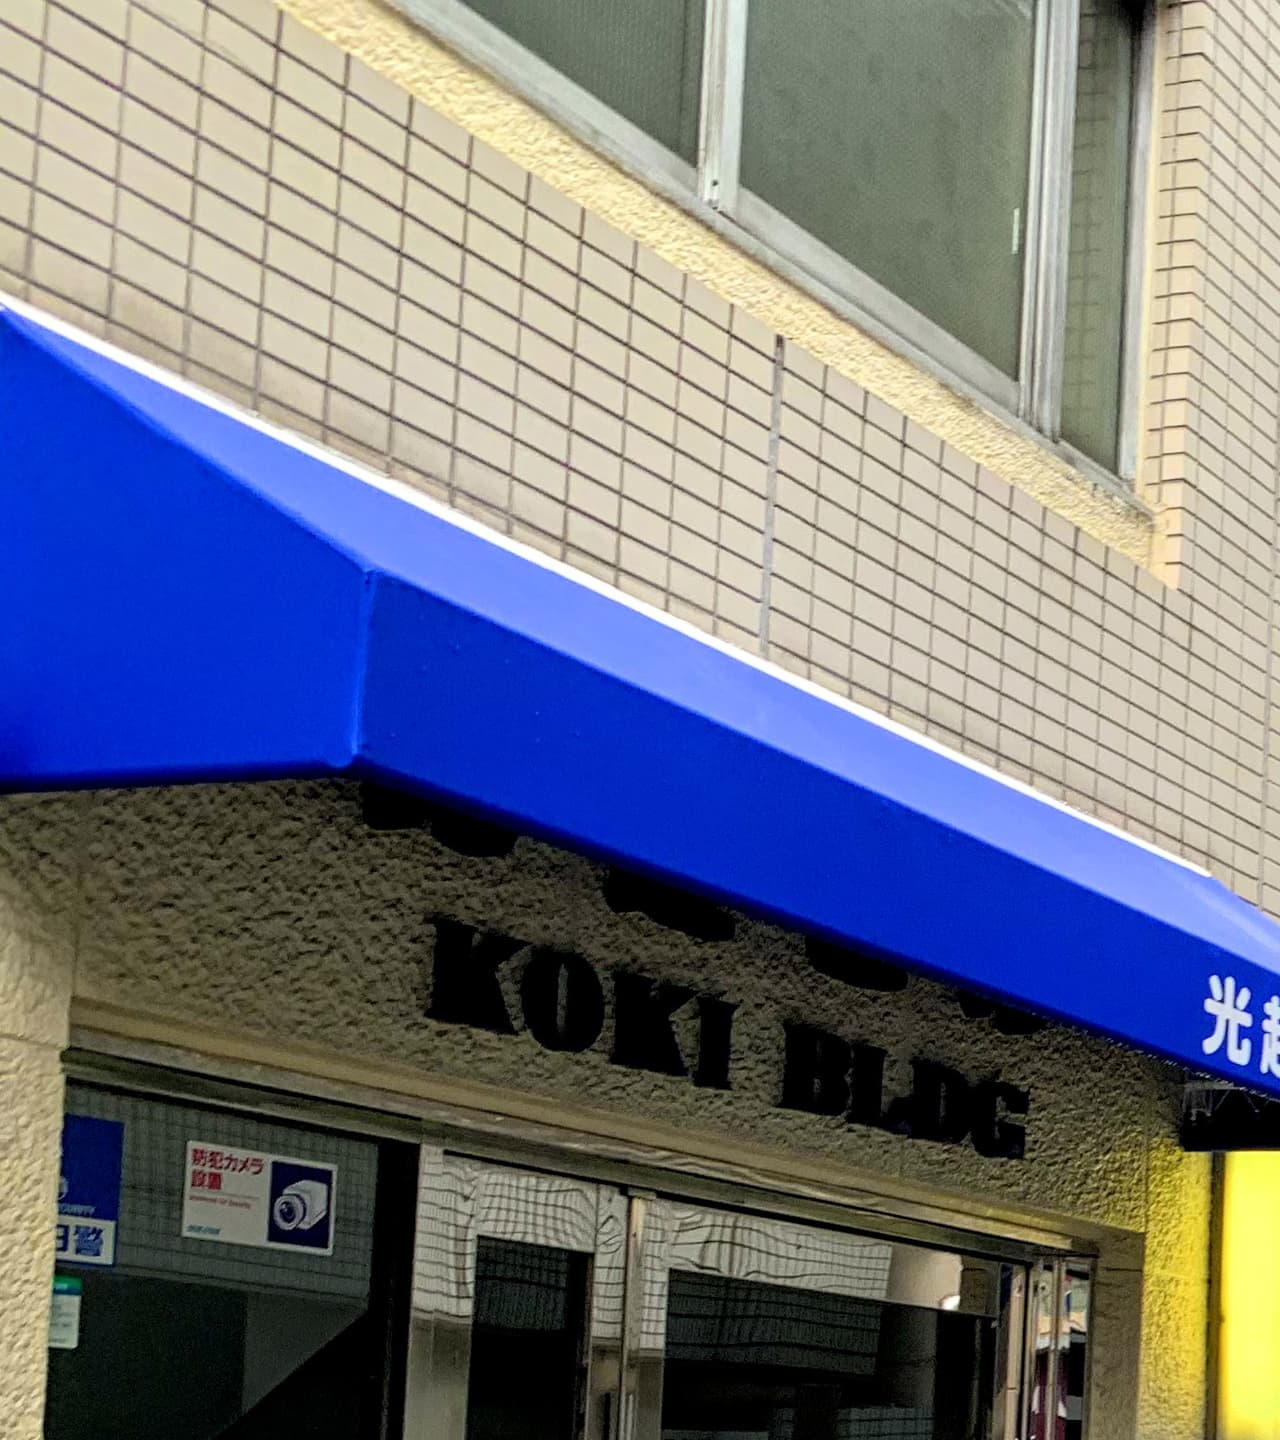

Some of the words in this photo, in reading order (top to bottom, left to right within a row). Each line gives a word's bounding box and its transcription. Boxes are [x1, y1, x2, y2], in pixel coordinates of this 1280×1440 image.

[424, 915, 742, 1091] KOKI
[768, 1018, 1031, 1160] BLDG
[191, 1148, 265, 1175] 防犯カメラ
[191, 1169, 223, 1191] 設置
